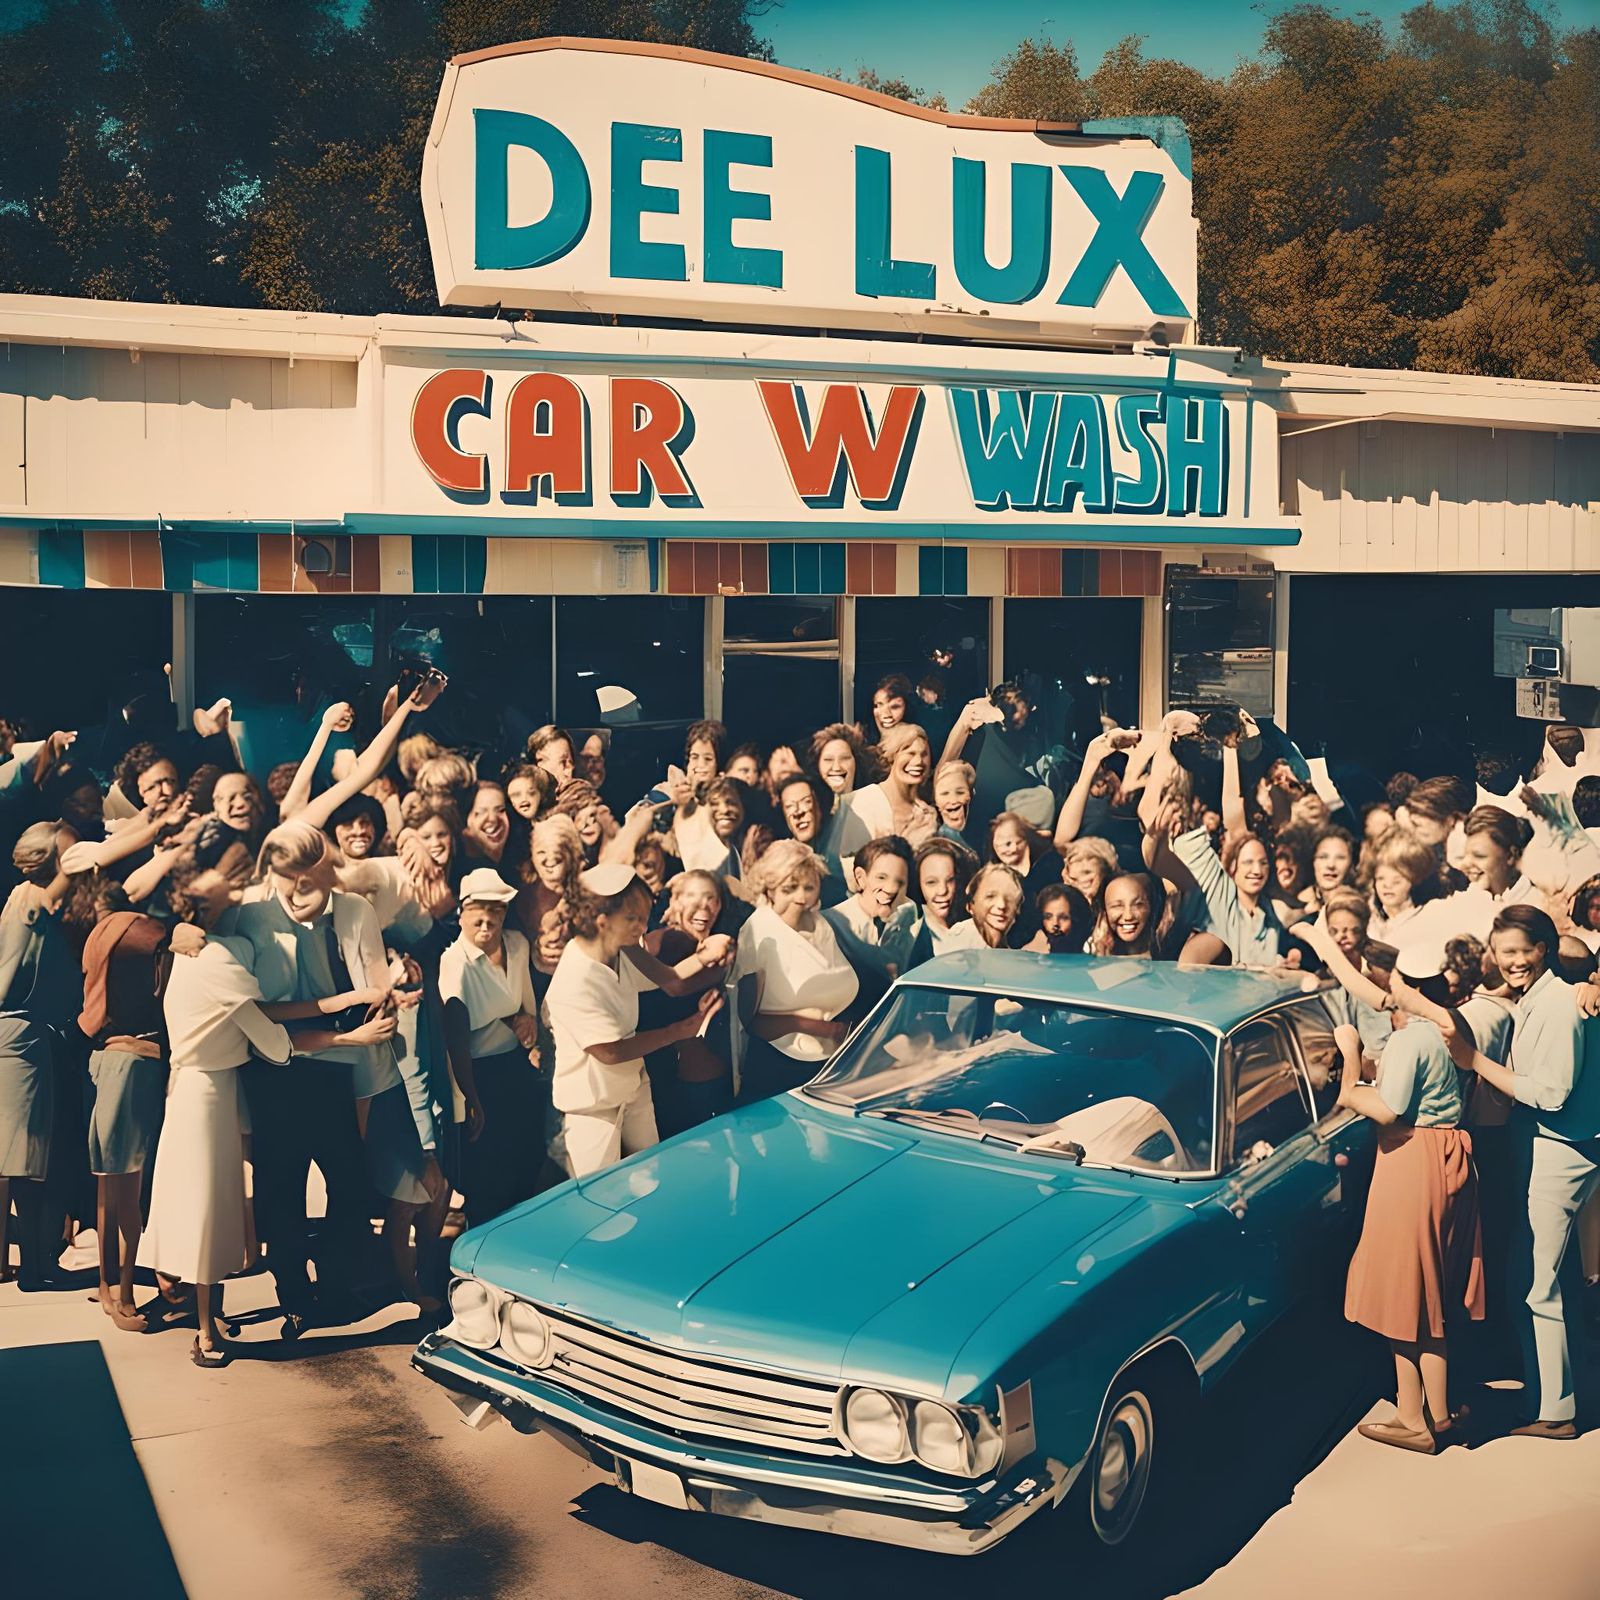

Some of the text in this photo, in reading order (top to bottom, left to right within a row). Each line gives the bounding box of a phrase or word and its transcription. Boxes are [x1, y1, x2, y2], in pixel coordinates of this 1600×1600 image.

[474, 108, 1193, 317] DEE LUX
[411, 369, 1229, 516] CAR W WASH
